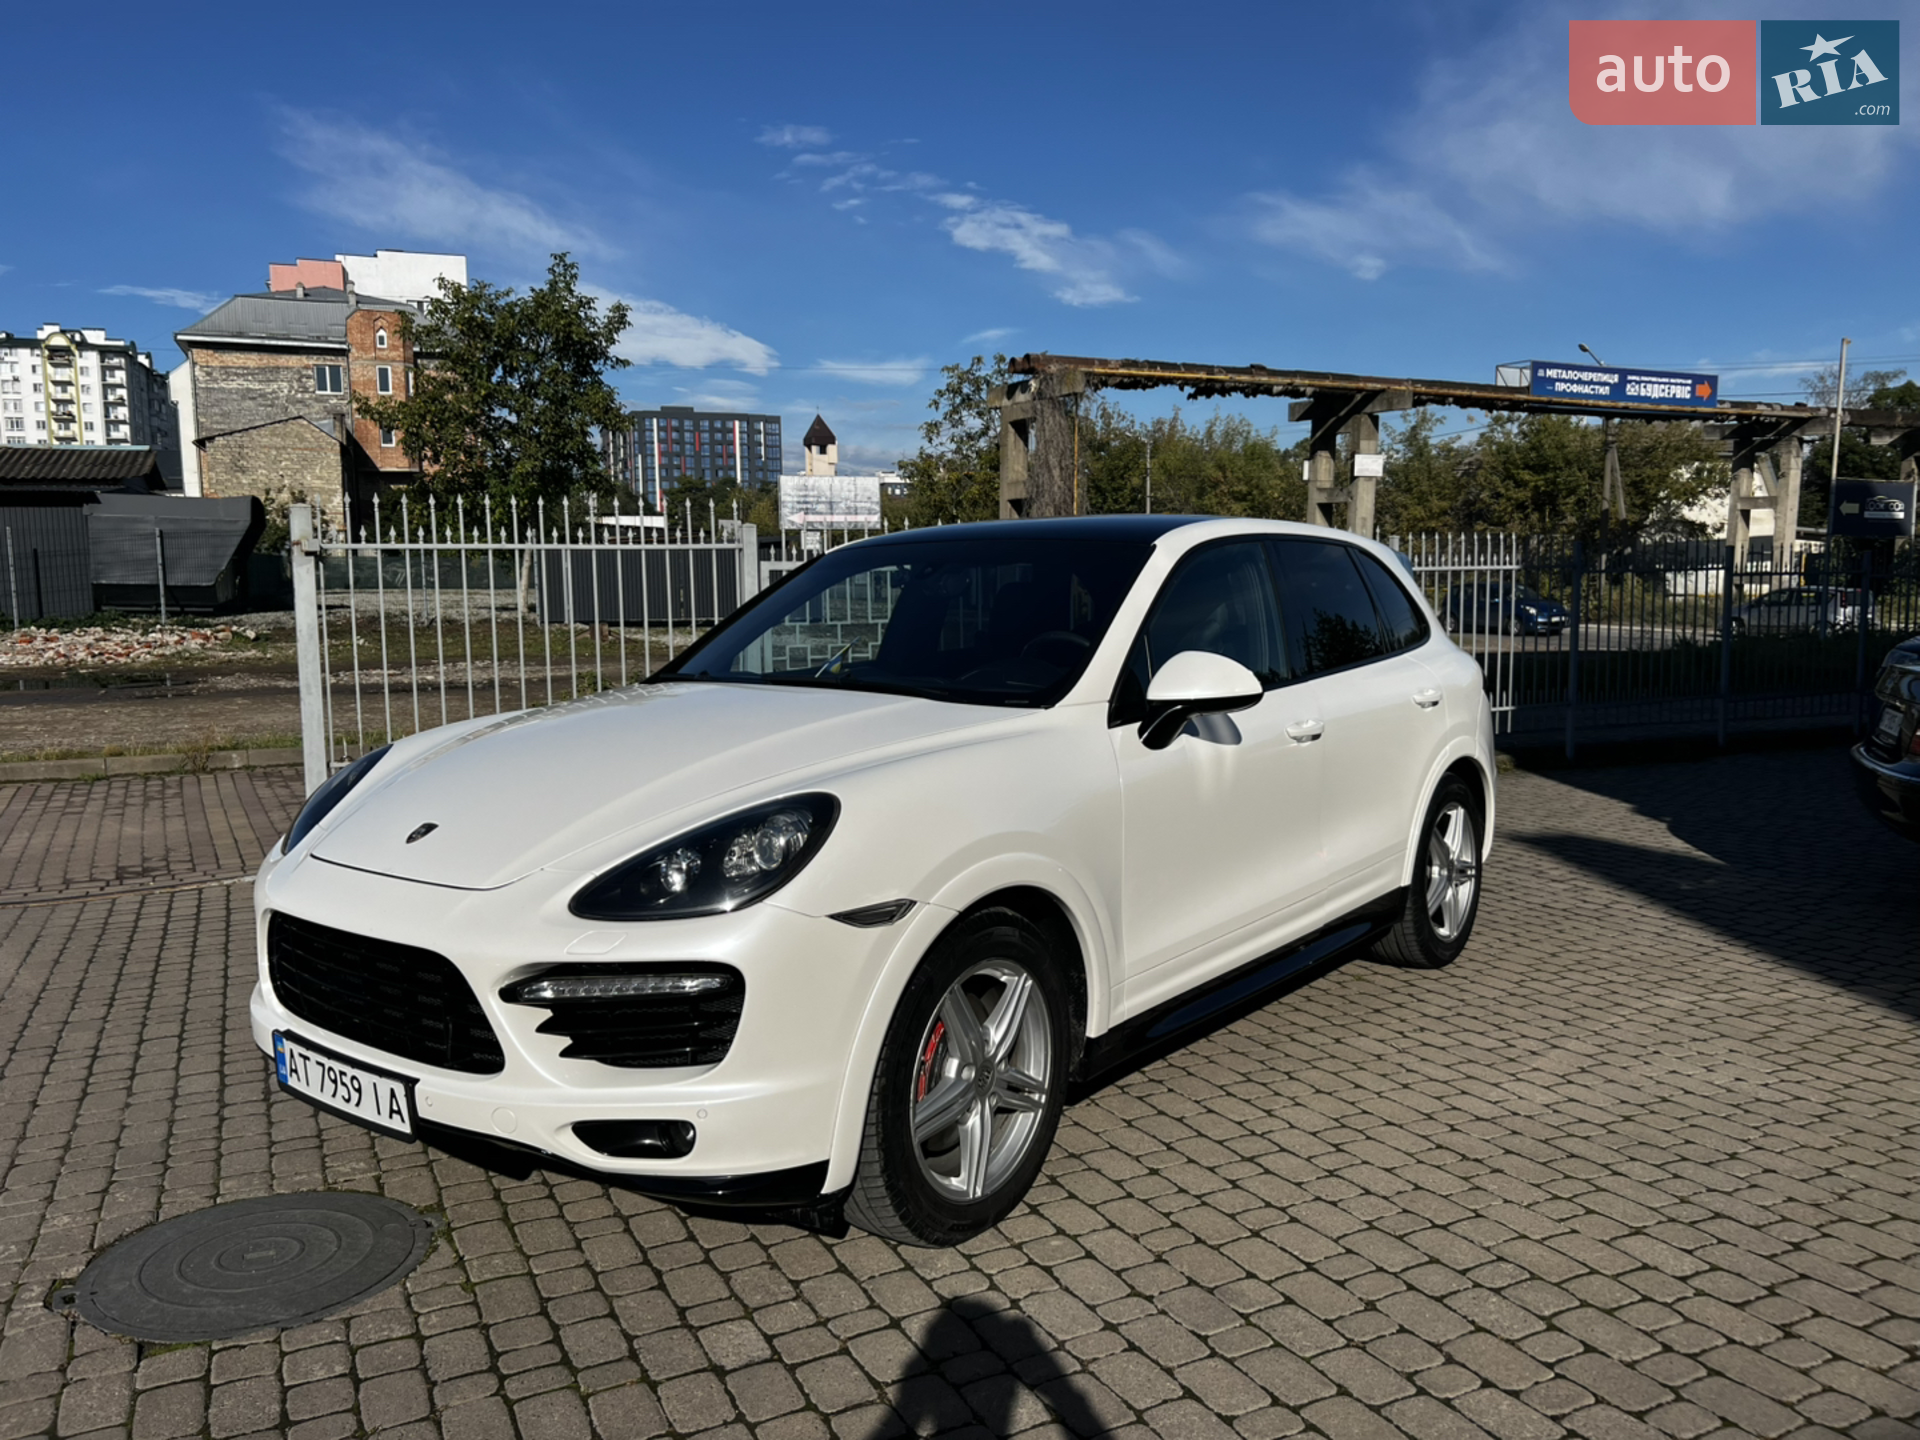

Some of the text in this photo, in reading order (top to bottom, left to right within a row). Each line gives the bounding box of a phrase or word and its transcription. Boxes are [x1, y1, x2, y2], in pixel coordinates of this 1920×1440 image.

[1546, 368, 1619, 384] МЕТАЛОЧЕРЕПИЦЯ
[1555, 382, 1610, 396] ПРОФНАСТИЛ
[1639, 382, 1691, 399] БУДСЕРВІС
[289, 1047, 406, 1124] AT 7959 IA
